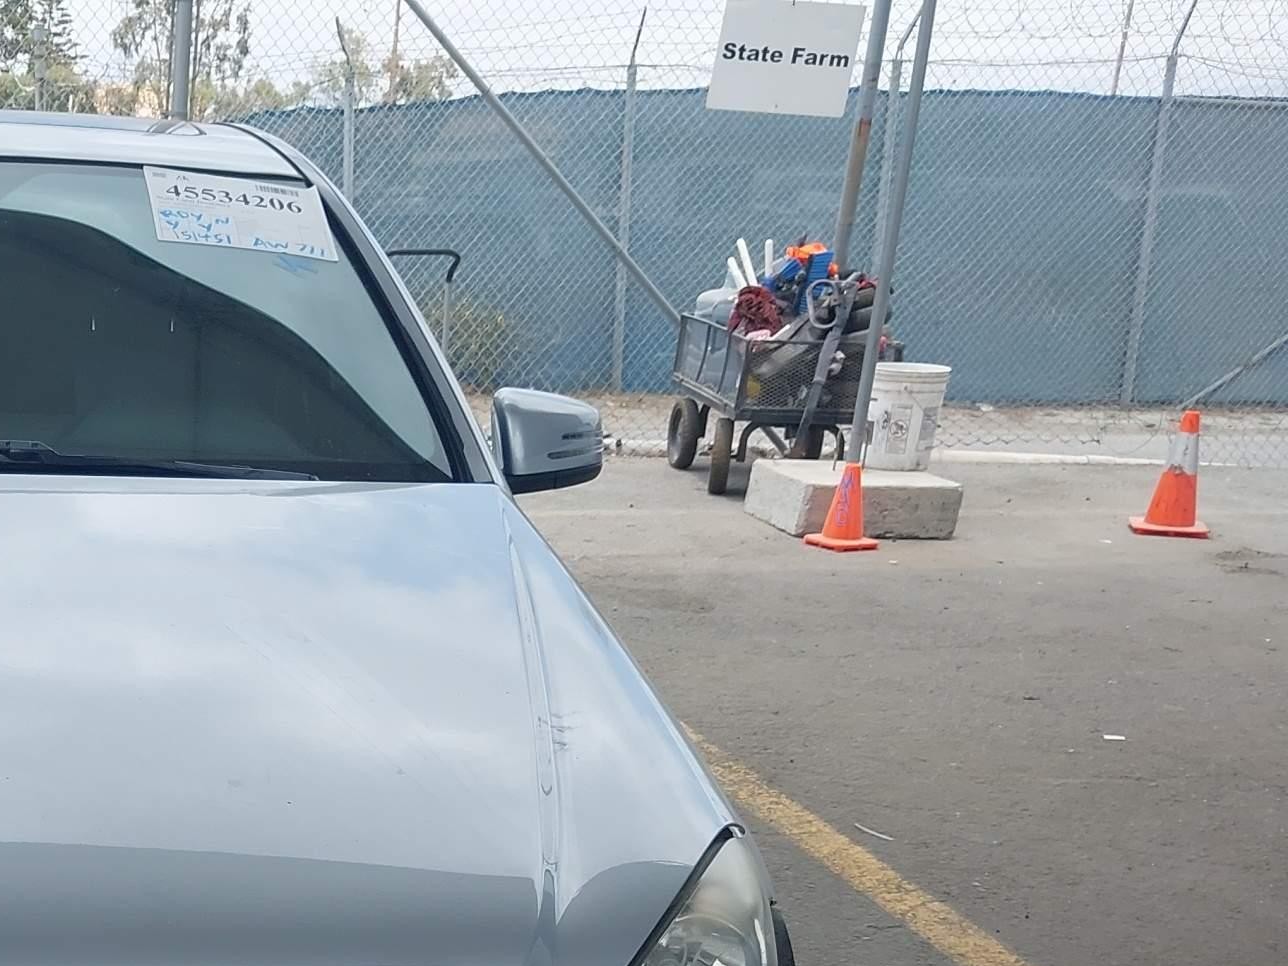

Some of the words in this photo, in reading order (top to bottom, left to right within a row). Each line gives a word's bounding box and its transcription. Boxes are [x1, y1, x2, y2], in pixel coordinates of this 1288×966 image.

[722, 42, 784, 63] State
[791, 47, 850, 68] Farm
[165, 184, 303, 214] 45534206
